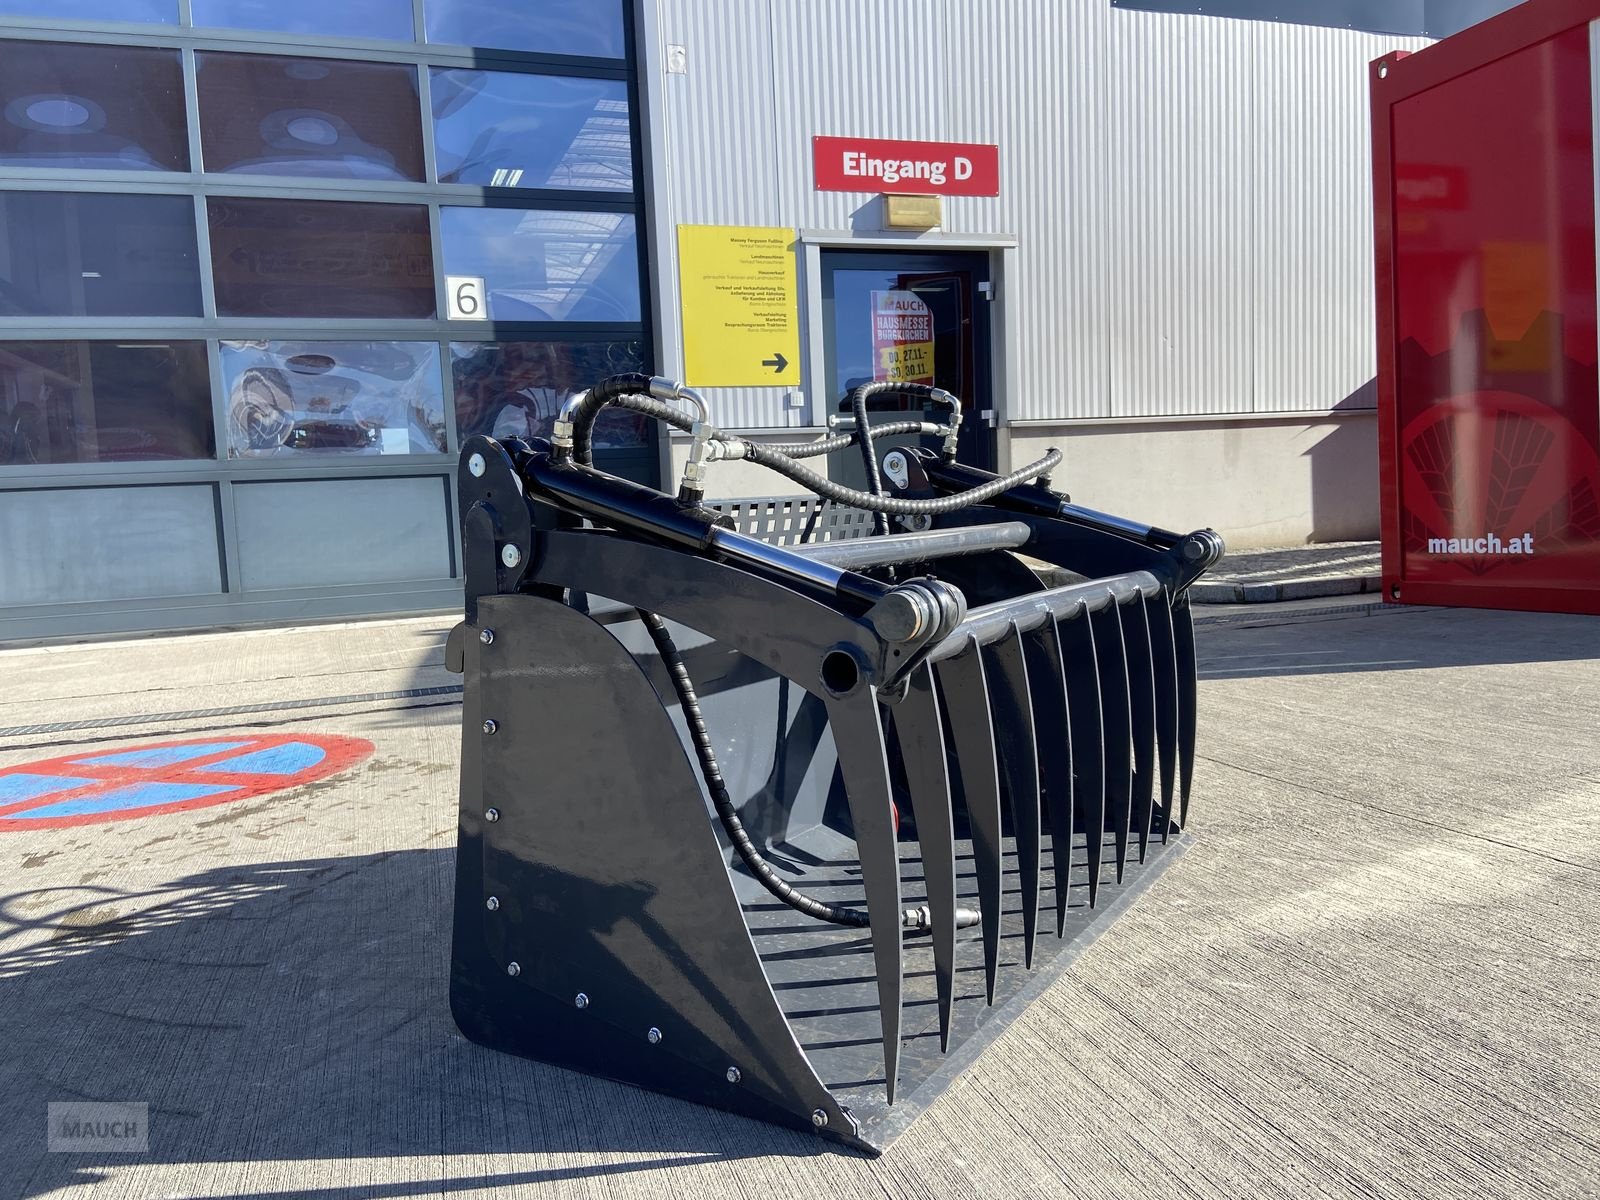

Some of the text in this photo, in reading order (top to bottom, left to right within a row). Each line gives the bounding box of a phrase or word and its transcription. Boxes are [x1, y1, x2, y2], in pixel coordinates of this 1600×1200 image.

[842, 151, 973, 185] Eingang D
[456, 282, 479, 315] 6
[877, 317, 929, 330] HAUSMESSE
[877, 329, 929, 341] BURGKIRCHEN
[888, 351, 902, 364] DO,
[890, 363, 929, 379] SO, 30.11.
[1428, 532, 1534, 554] mauch.at
